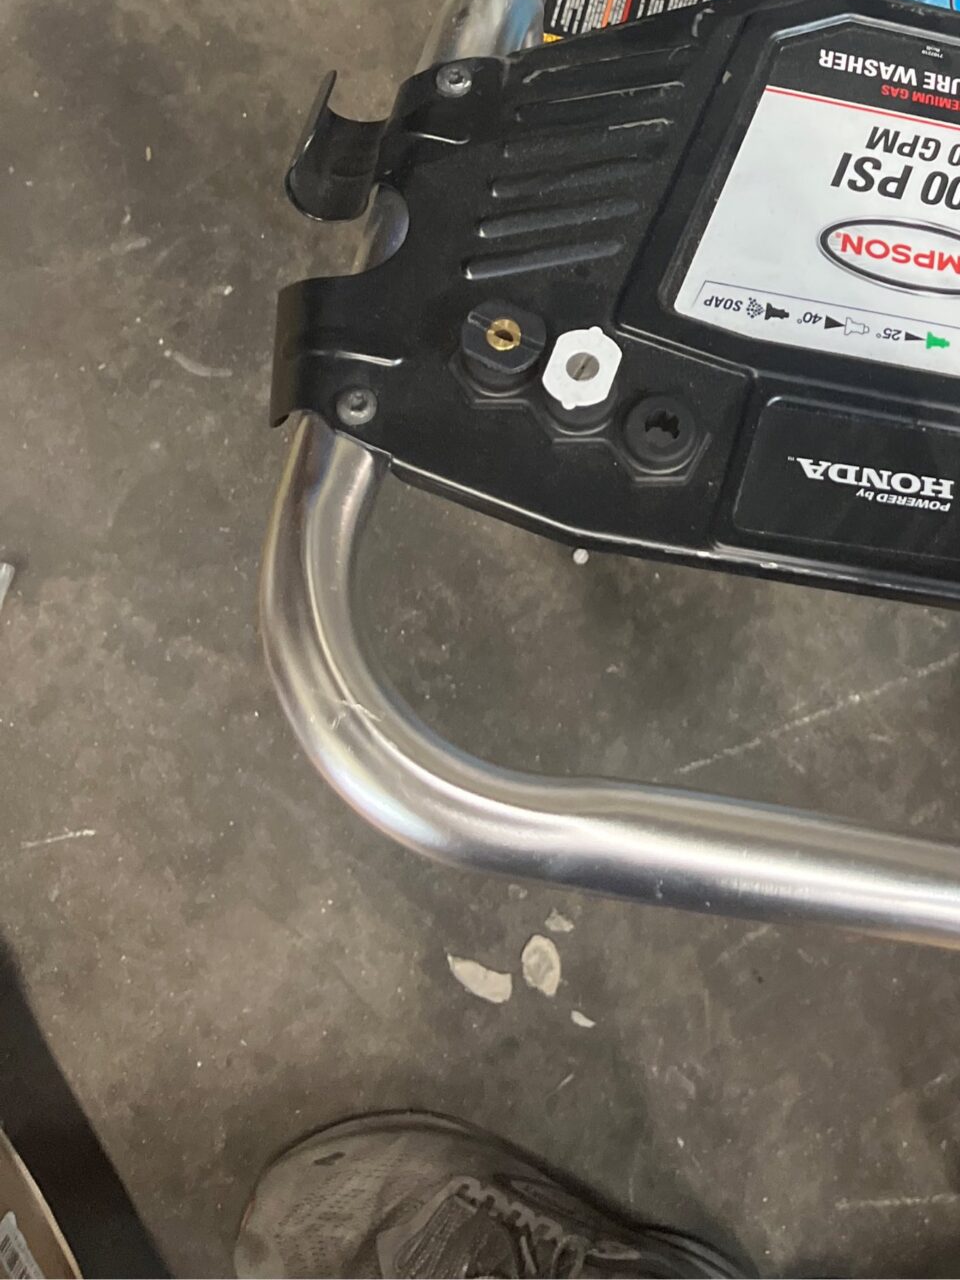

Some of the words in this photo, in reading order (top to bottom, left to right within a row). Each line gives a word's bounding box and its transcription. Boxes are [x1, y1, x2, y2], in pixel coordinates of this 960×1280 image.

[818, 48, 918, 86] WASHER
[880, 84, 909, 100] GAS
[865, 126, 942, 162] GPM
[830, 152, 914, 200] PSI
[702, 294, 743, 312] SOAP
[796, 310, 823, 326] 40°
[875, 326, 902, 342] 25°
[796, 457, 954, 500] HONDA
[856, 488, 874, 501] by
[876, 493, 951, 512] POWERED
